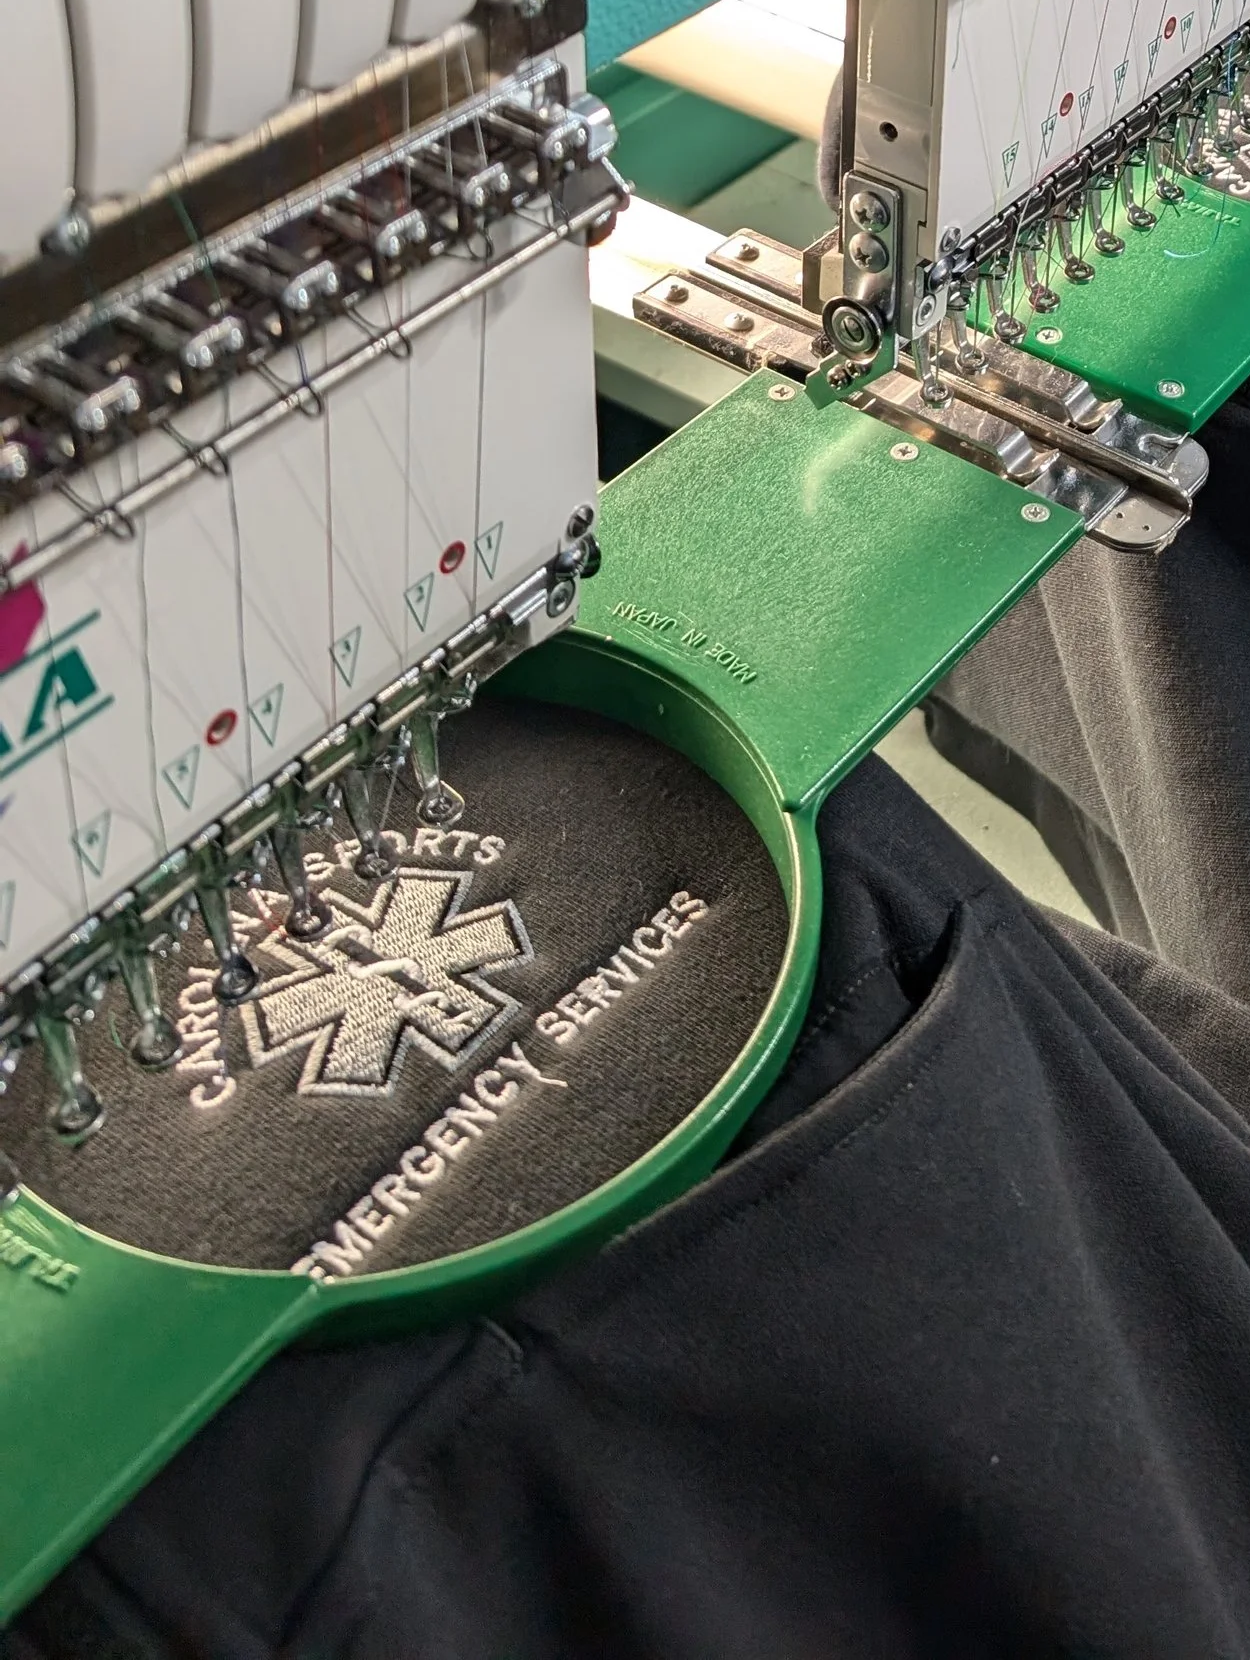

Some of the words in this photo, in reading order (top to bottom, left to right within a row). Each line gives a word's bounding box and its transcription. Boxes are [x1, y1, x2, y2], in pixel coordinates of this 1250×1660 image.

[612, 601, 677, 631] JAPAN
[681, 628, 707, 647] IN
[705, 642, 757, 684] MADE
[535, 890, 709, 1045] SERVICES
